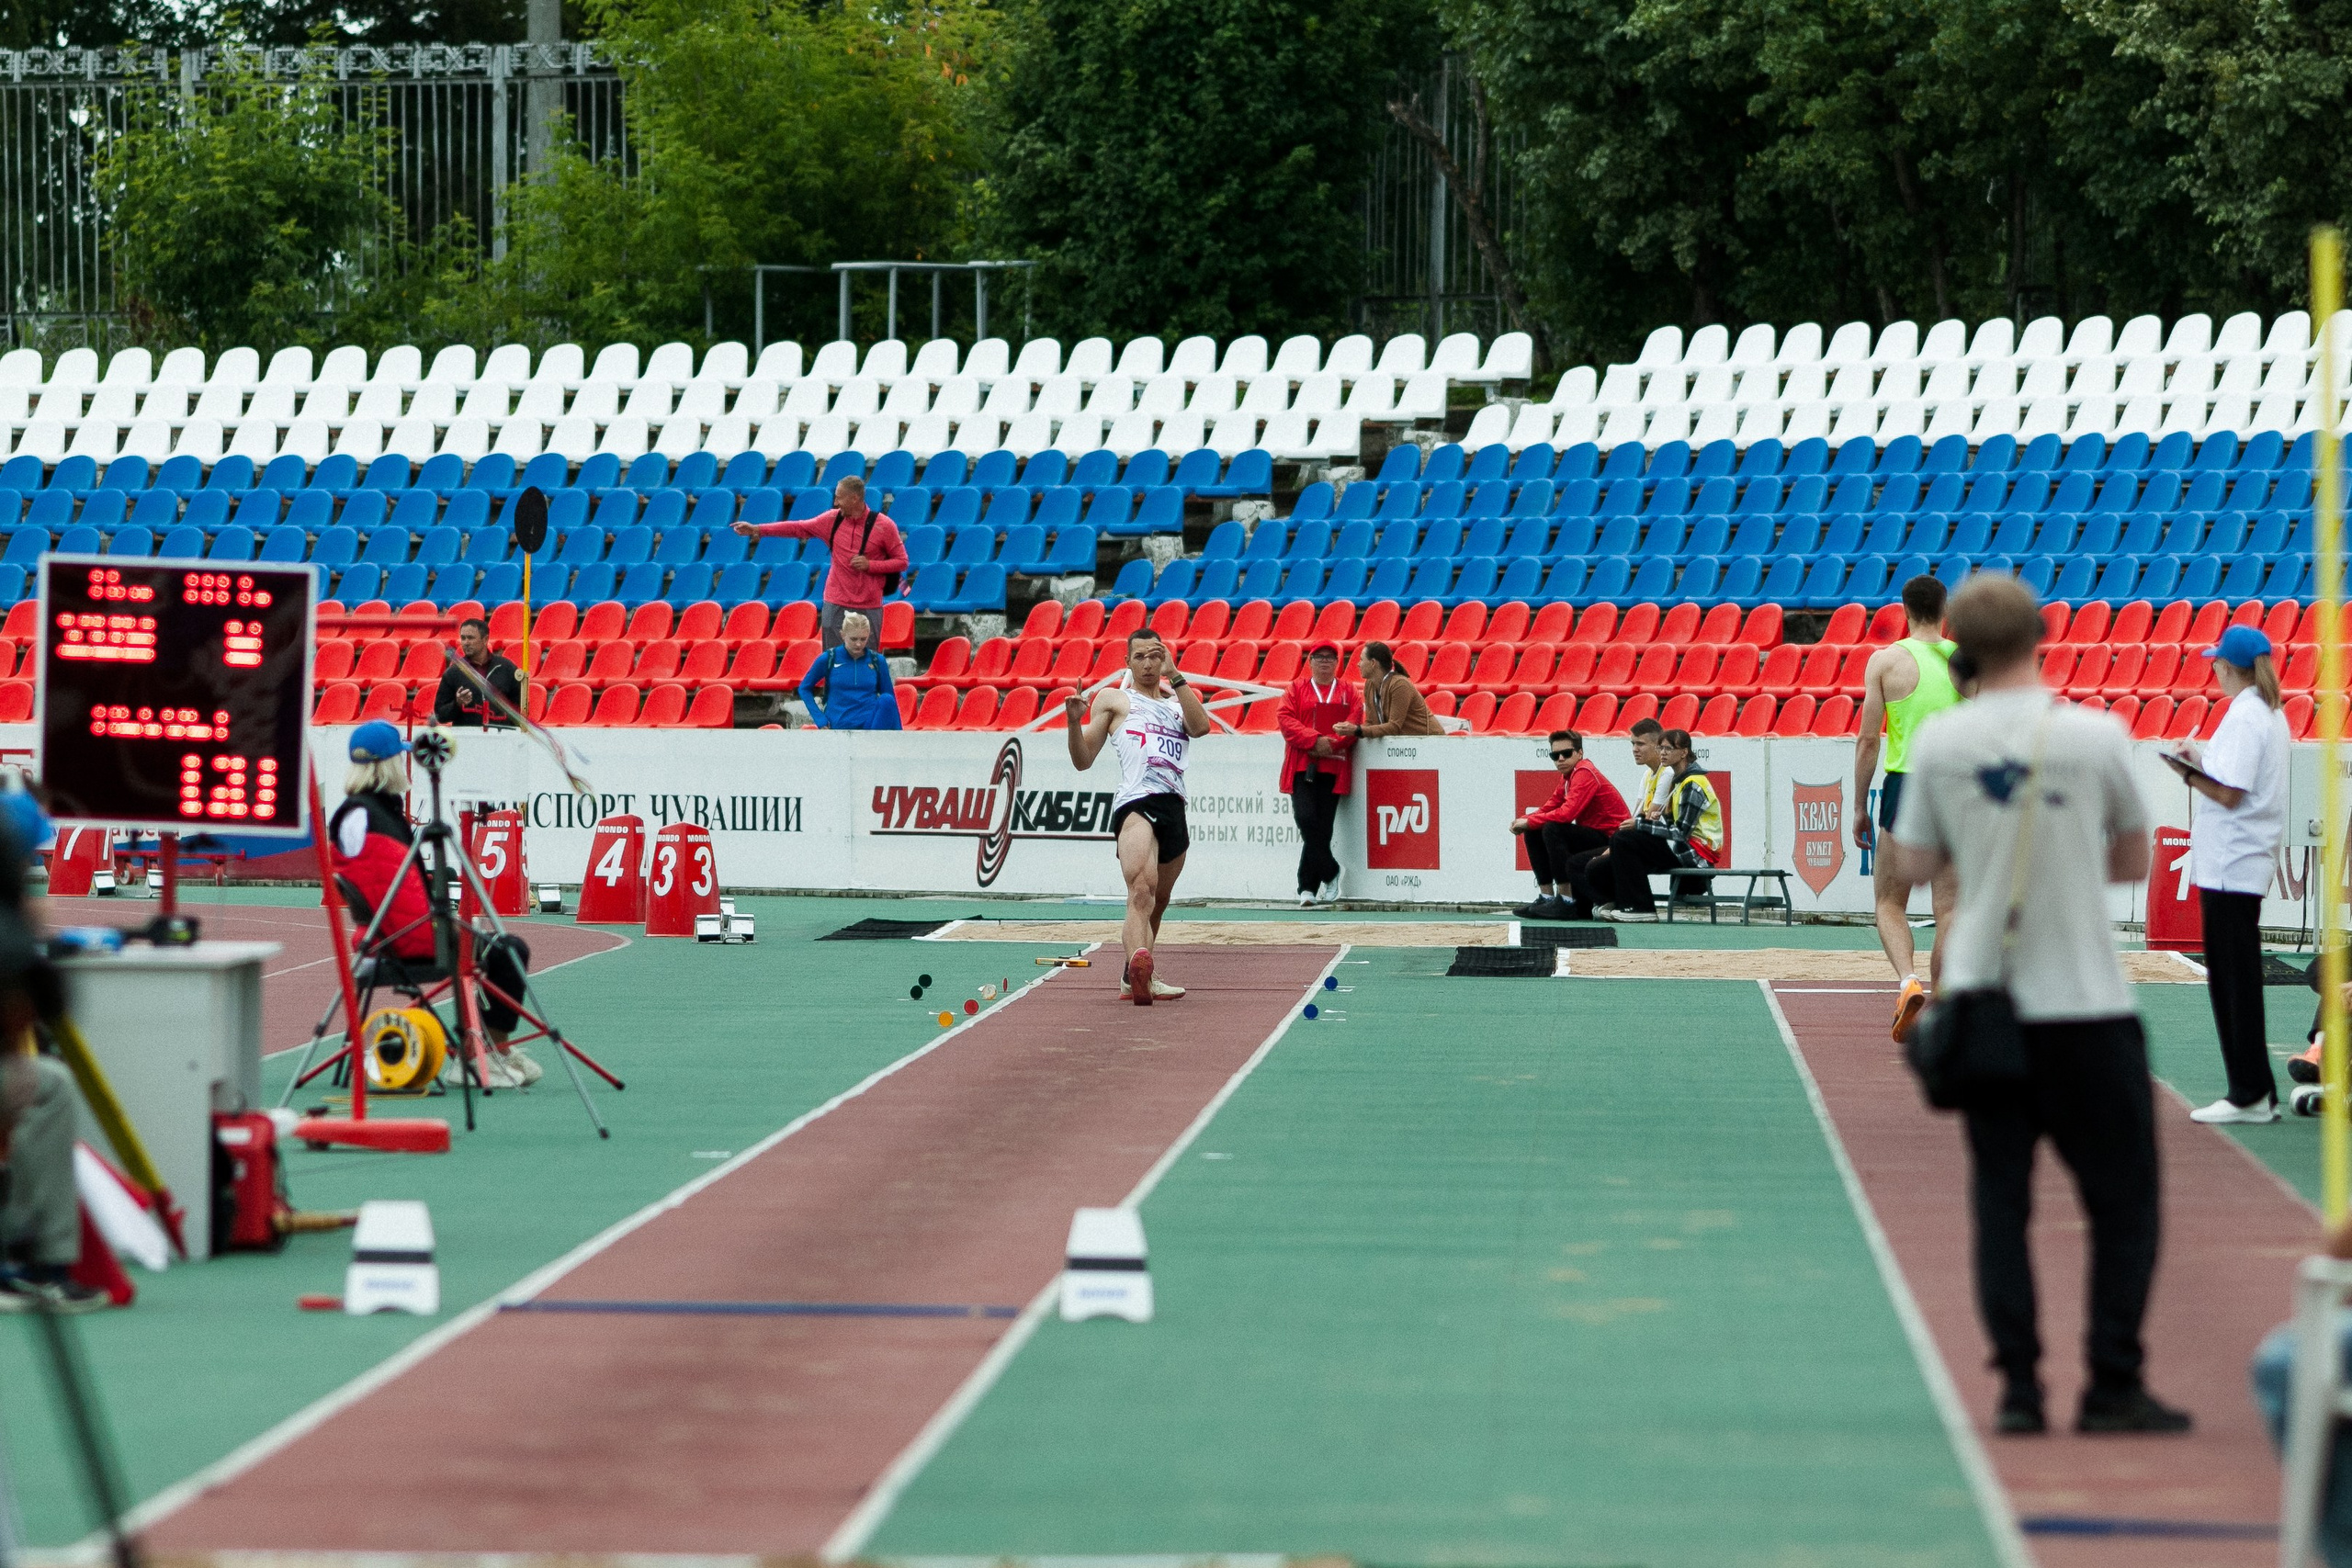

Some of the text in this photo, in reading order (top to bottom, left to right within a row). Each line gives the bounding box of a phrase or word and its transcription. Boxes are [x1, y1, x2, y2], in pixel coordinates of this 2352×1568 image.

[1157, 736, 1182, 761] 209
[1386, 748, 1417, 760] спонсор
[649, 794, 804, 832] ЧУВАШИИ
[872, 786, 997, 829] ЧУВАШ
[1186, 790, 1264, 818] ксарский
[1798, 801, 1838, 832] КВАС
[597, 825, 629, 834] MONDO
[657, 834, 680, 843] MONDO
[687, 834, 711, 843] MONDO
[2162, 838, 2192, 846] MOND
[479, 831, 509, 879] 5
[594, 838, 627, 886] 4
[1805, 840, 1833, 856] БУКЕТ
[653, 846, 677, 897] 3
[692, 846, 713, 897] 3
[1385, 874, 1399, 886] ОАО
[2169, 849, 2192, 901] 1
